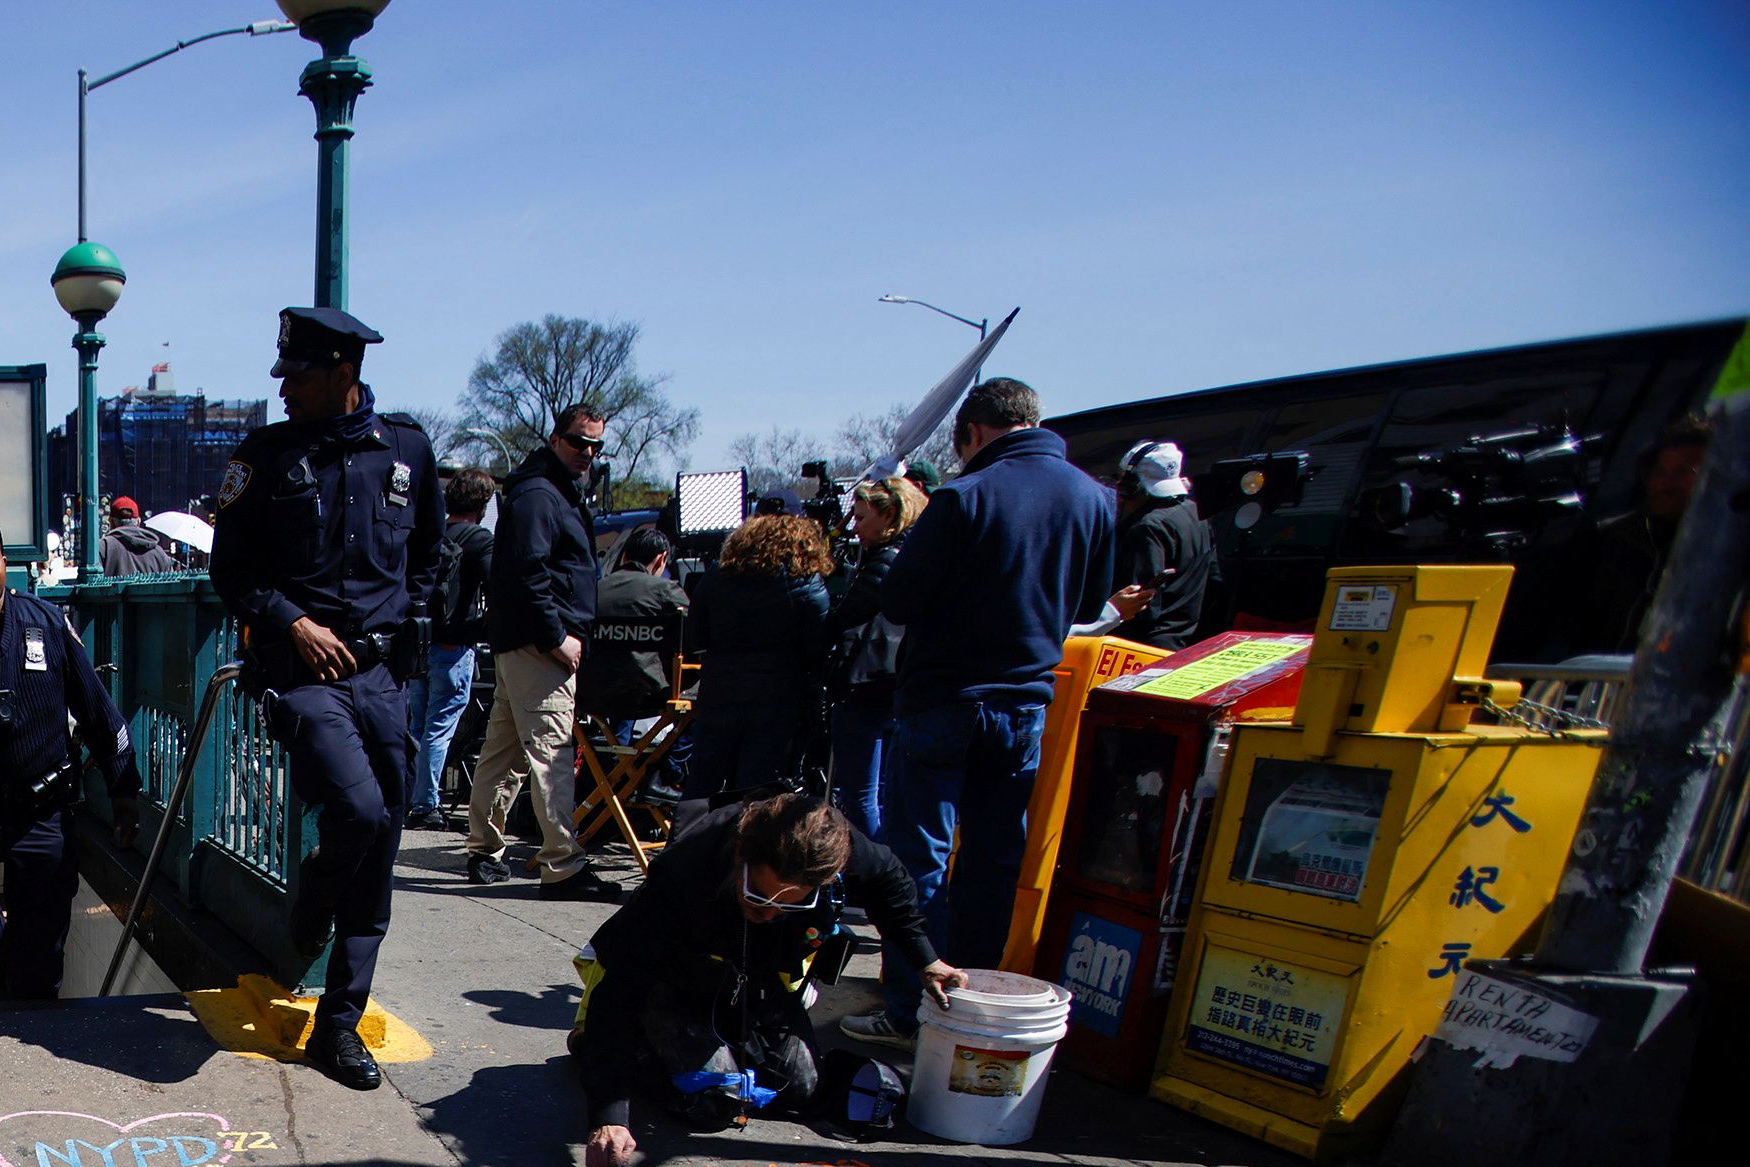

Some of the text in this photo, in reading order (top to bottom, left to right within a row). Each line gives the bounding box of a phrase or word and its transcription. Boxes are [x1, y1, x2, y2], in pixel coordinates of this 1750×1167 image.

[598, 624, 665, 642] MSNBC
[1096, 649, 1118, 677] El
[1427, 789, 1532, 979] 大紀元
[1065, 933, 1133, 998] am
[1459, 975, 1550, 1019] RENTA
[216, 1131, 278, 1152] 72
